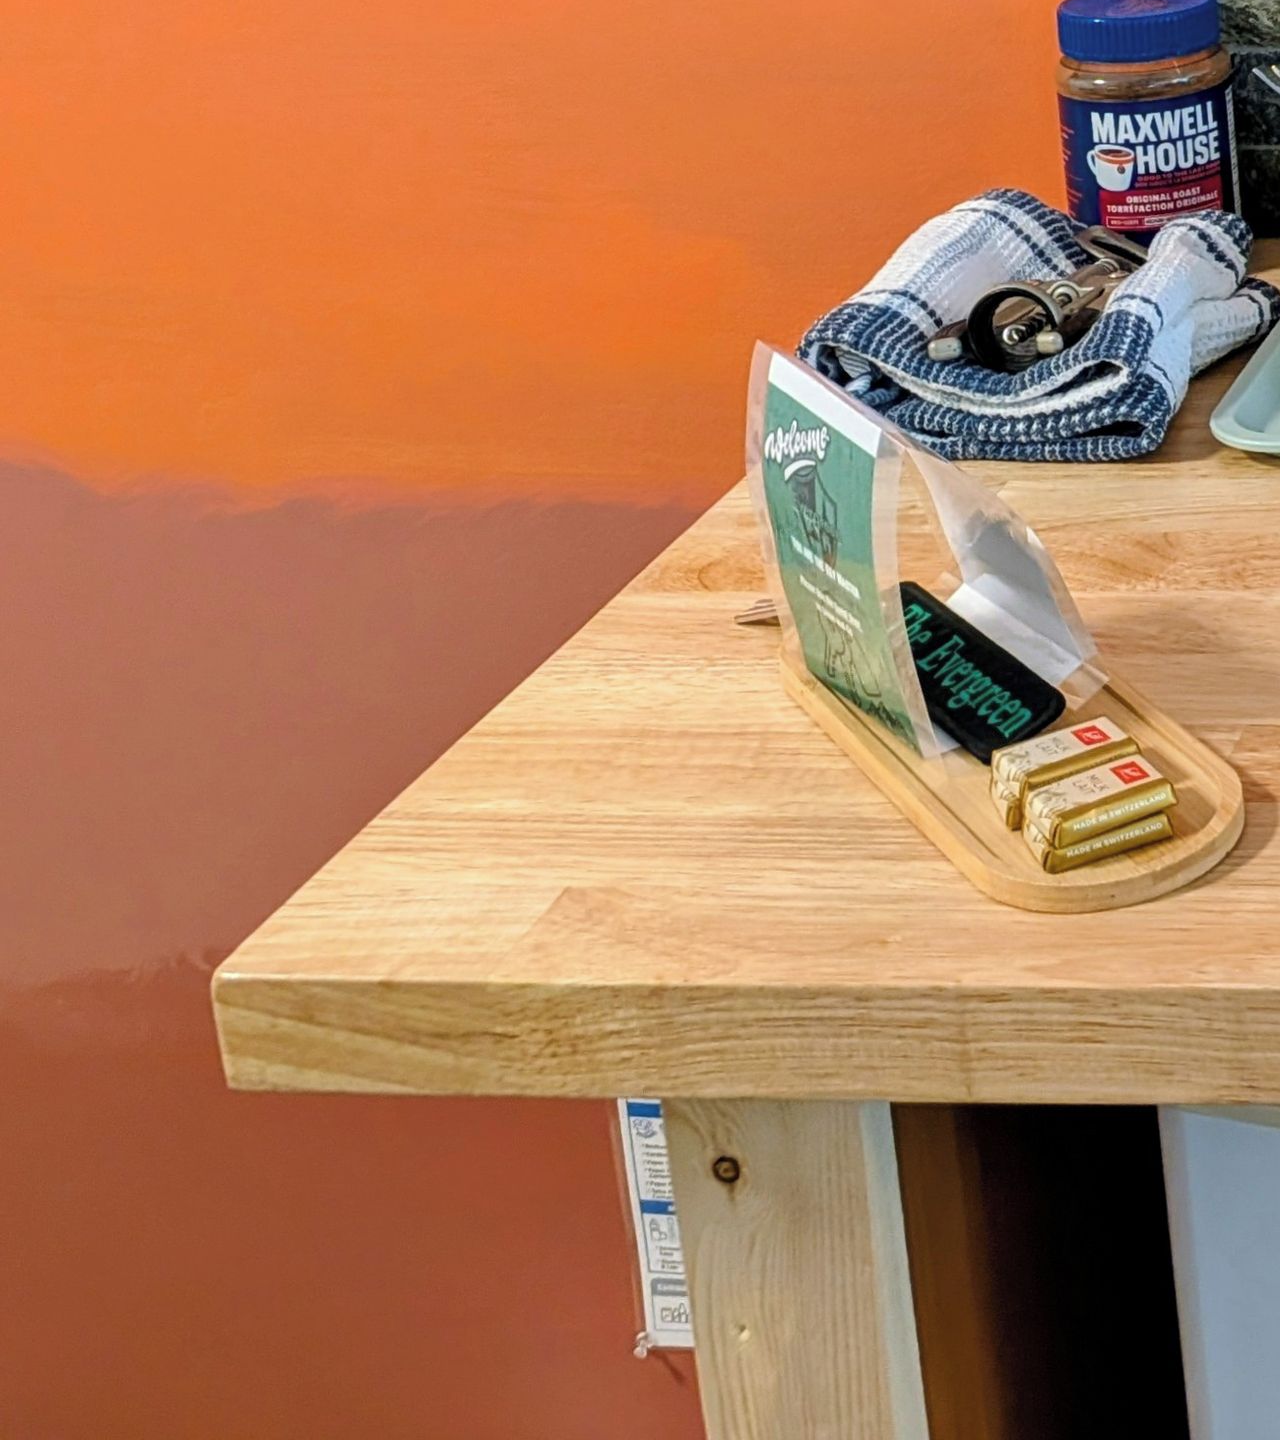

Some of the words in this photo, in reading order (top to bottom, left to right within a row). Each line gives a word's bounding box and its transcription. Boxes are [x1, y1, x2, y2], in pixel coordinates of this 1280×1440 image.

[1090, 101, 1218, 144] MAXWELL
[1135, 129, 1220, 175] HOUSE
[1126, 193, 1170, 204] ORIGINAL
[1173, 186, 1201, 199] ROAST
[905, 603, 932, 644] The
[916, 634, 1032, 738] Evergreen
[1073, 819, 1097, 832] MADE
[1098, 814, 1108, 823] IN
[1109, 792, 1167, 820] SWITZERLAND
[1066, 845, 1091, 858] MADE
[1092, 840, 1103, 850] IN
[1103, 821, 1163, 847] SWITZERLAND
